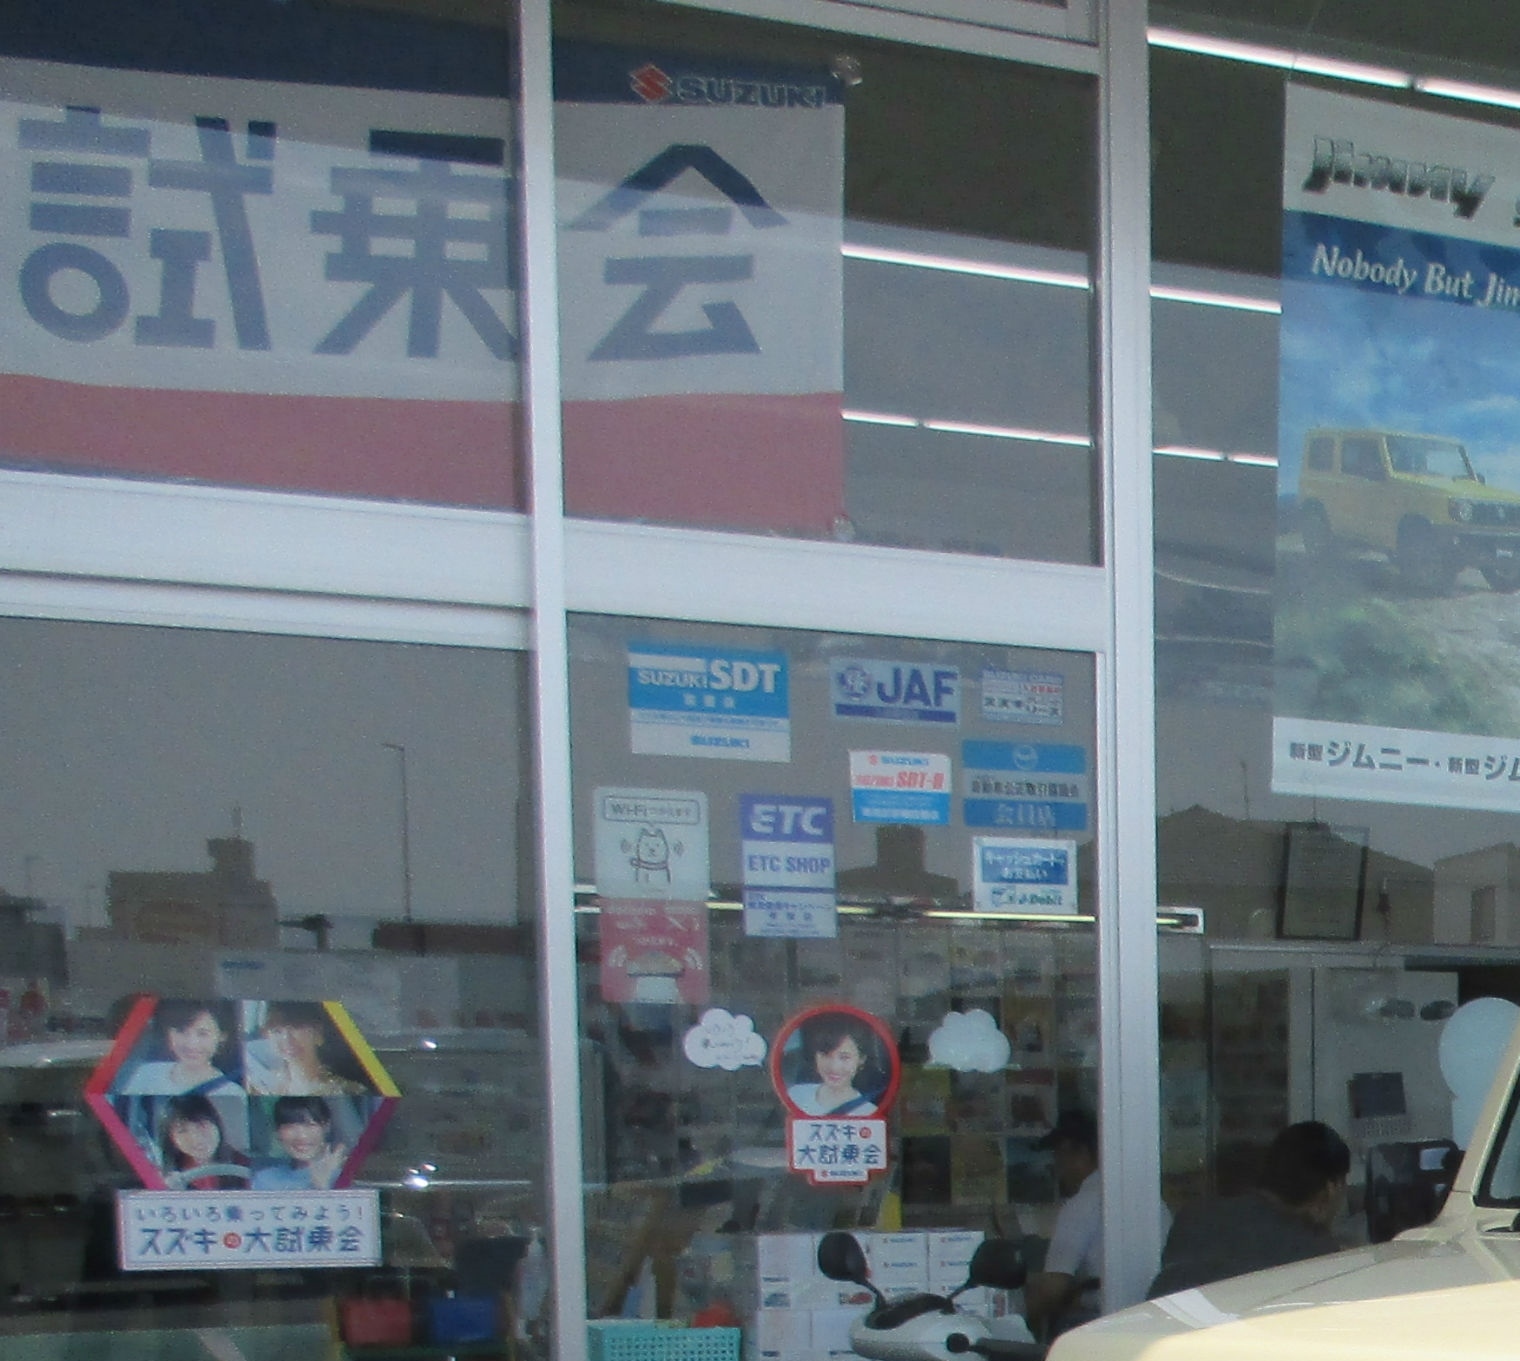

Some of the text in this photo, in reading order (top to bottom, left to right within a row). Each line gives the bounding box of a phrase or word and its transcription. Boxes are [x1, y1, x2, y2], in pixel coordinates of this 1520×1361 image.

[676, 75, 827, 108] SUZUKI
[1303, 134, 1496, 220] Jimny
[17, 105, 788, 363] 試乗会
[1311, 243, 1417, 294] Nobody
[1423, 264, 1474, 301] But
[637, 658, 781, 693] SUZUKI SDT
[876, 667, 959, 708] JAF
[751, 803, 827, 836] ETC
[748, 855, 832, 874] ETC SHOP
[797, 1144, 882, 1165] 大試乗会
